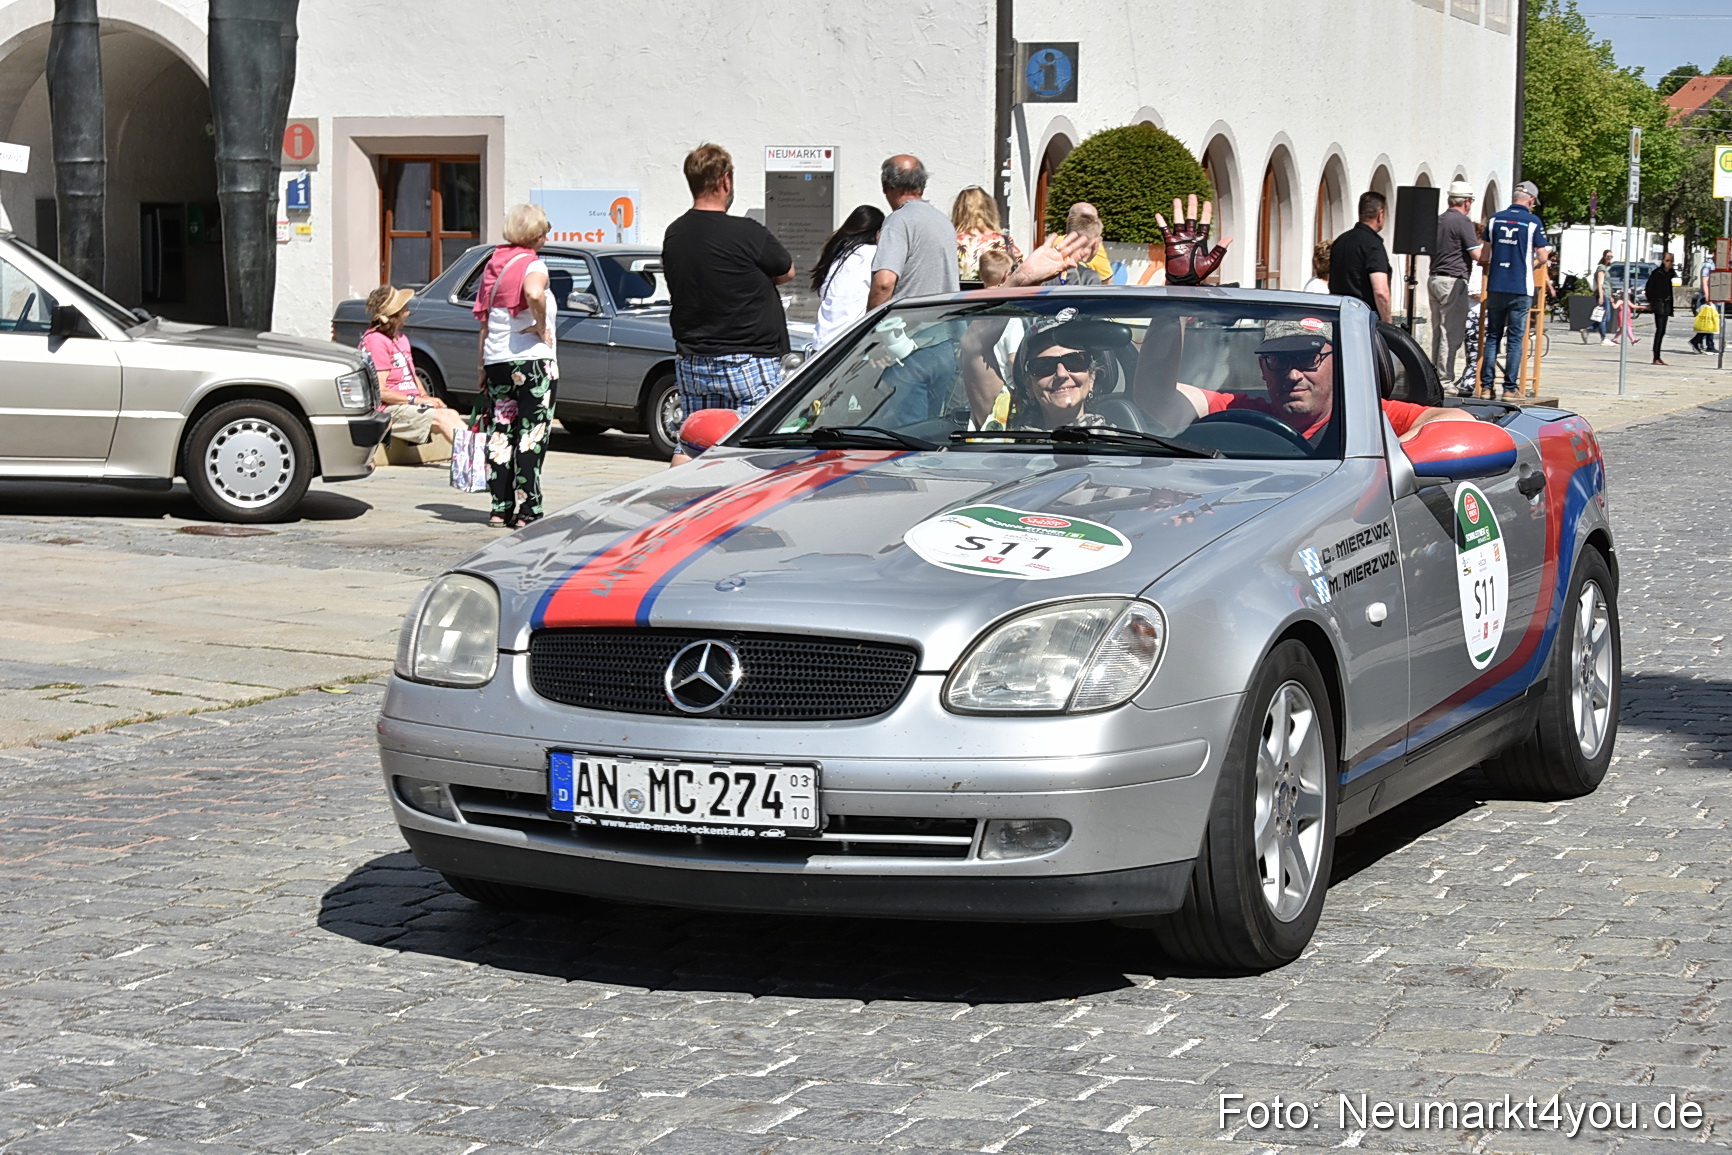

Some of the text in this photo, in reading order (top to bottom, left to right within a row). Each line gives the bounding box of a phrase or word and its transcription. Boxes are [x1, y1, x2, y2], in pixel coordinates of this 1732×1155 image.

[768, 150, 822, 158] NEUMARKT
[545, 228, 605, 243] unst
[955, 536, 1053, 560] S11
[1321, 522, 1392, 564] C. MIERZWA
[1328, 550, 1398, 596] M. MIERZWA
[1474, 576, 1495, 620] S11
[576, 762, 784, 819] AN MC 274
[790, 774, 809, 788] 03
[558, 788, 568, 802] D
[792, 807, 810, 820] 10
[600, 819, 756, 838] www.auto-macht-eckental.de
